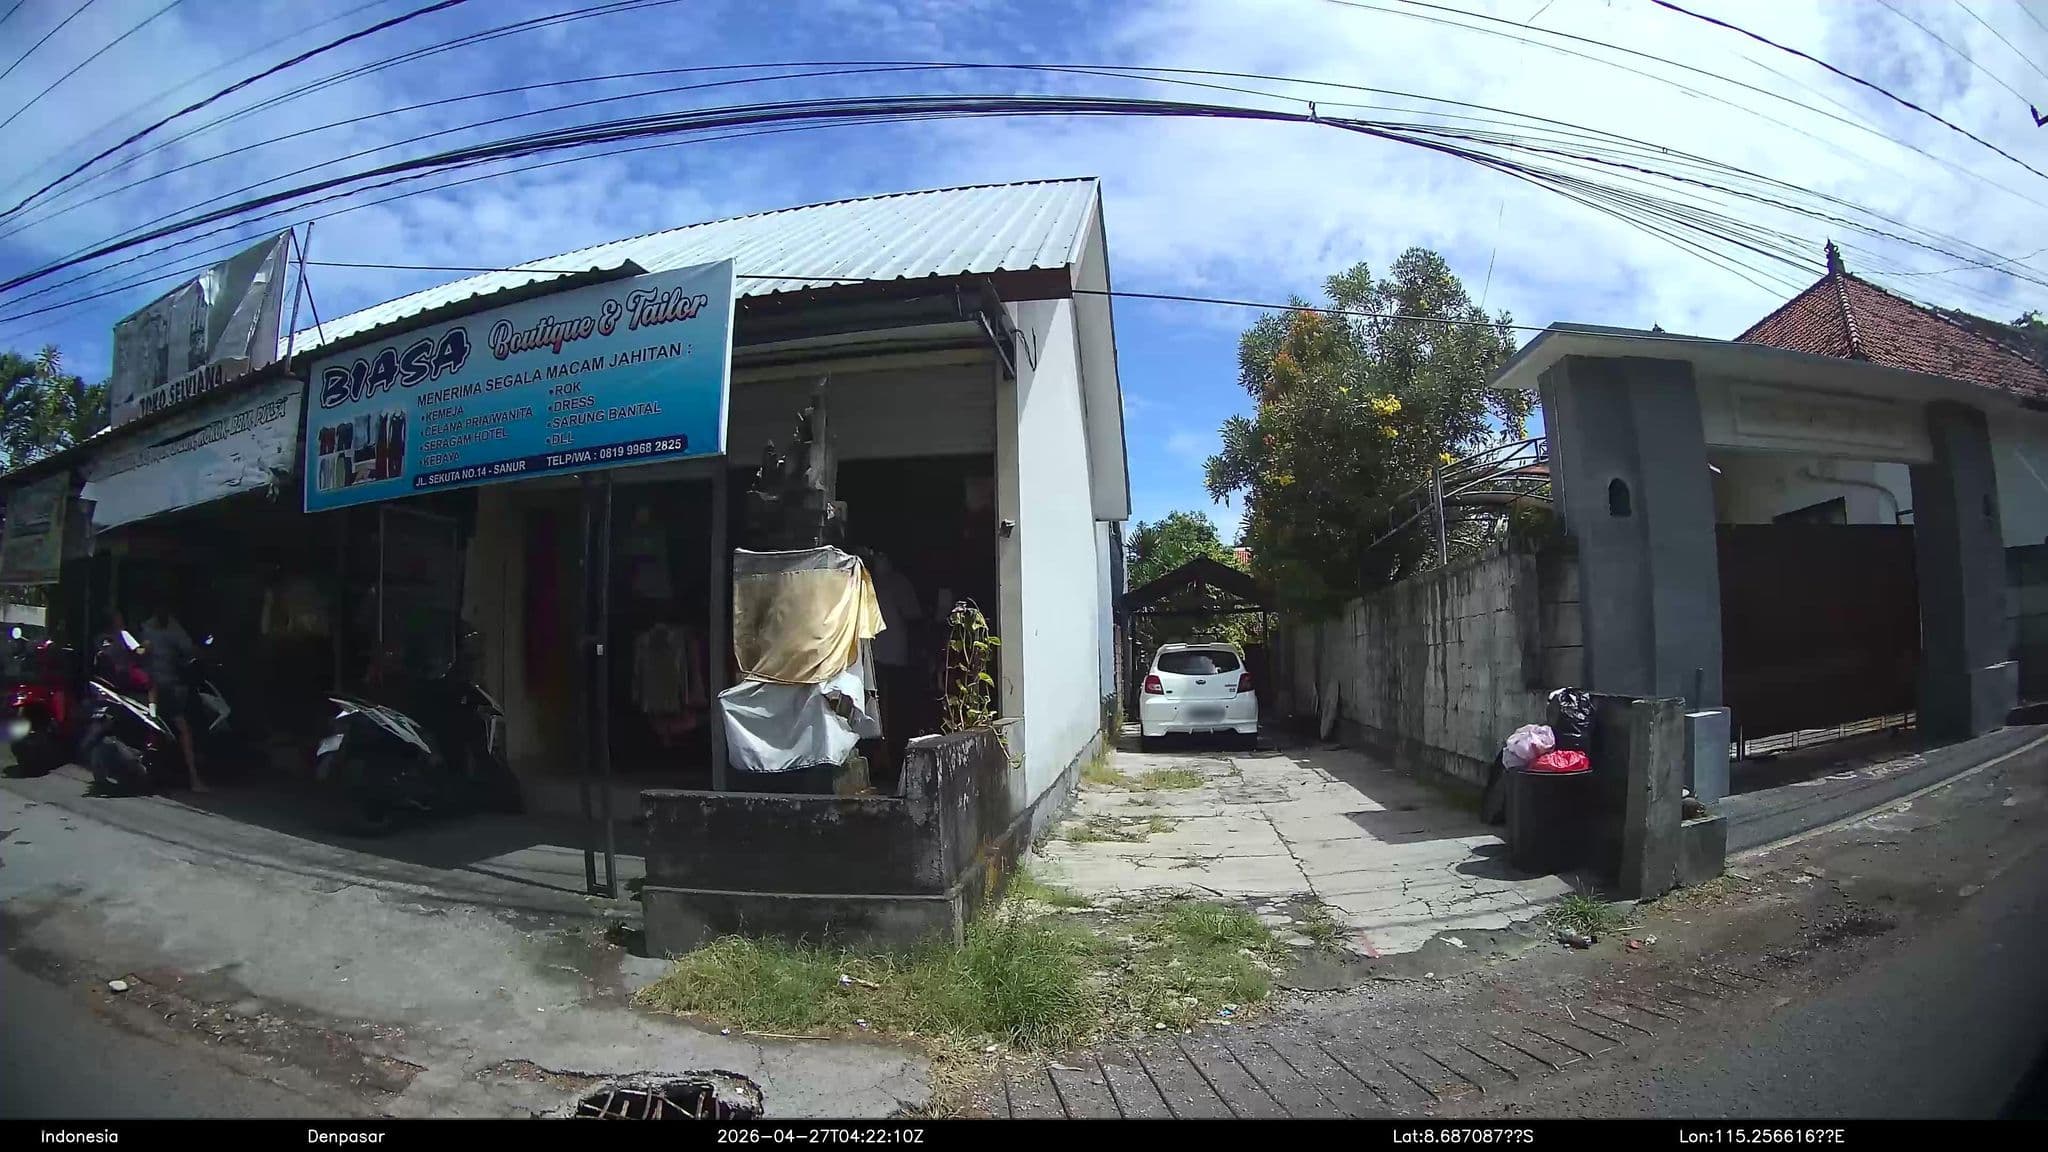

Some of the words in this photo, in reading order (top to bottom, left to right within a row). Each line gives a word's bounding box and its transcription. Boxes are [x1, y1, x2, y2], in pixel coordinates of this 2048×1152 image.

[488, 316, 595, 360] Boutique
[598, 299, 622, 336] &
[627, 287, 708, 331] Tailor
[320, 327, 472, 409] BIASA
[417, 382, 482, 407] MENERIMA
[486, 369, 542, 392] SEGALA
[546, 356, 604, 380] MACAM
[608, 342, 682, 368] JAHITAN
[554, 382, 581, 396] ROK
[426, 405, 464, 422] KEMEJA
[552, 411, 605, 429] SARUNG
[608, 402, 661, 420] BANTAL
[553, 395, 595, 413] DRESS
[425, 422, 463, 437] CELANA
[465, 405, 533, 427] PRIA/WANITA
[423, 434, 471, 452] SERAGAM
[474, 427, 509, 442] HOTEL
[552, 433, 575, 445] DLL
[423, 451, 460, 466] KEBAYA
[546, 450, 592, 467] TELP/WA
[599, 444, 624, 459] 0819
[626, 441, 652, 456] 9968
[654, 438, 682, 452] 2825
[428, 471, 461, 485] SEKUTA
[461, 466, 487, 480] NO.14
[493, 460, 526, 475] SANUR
